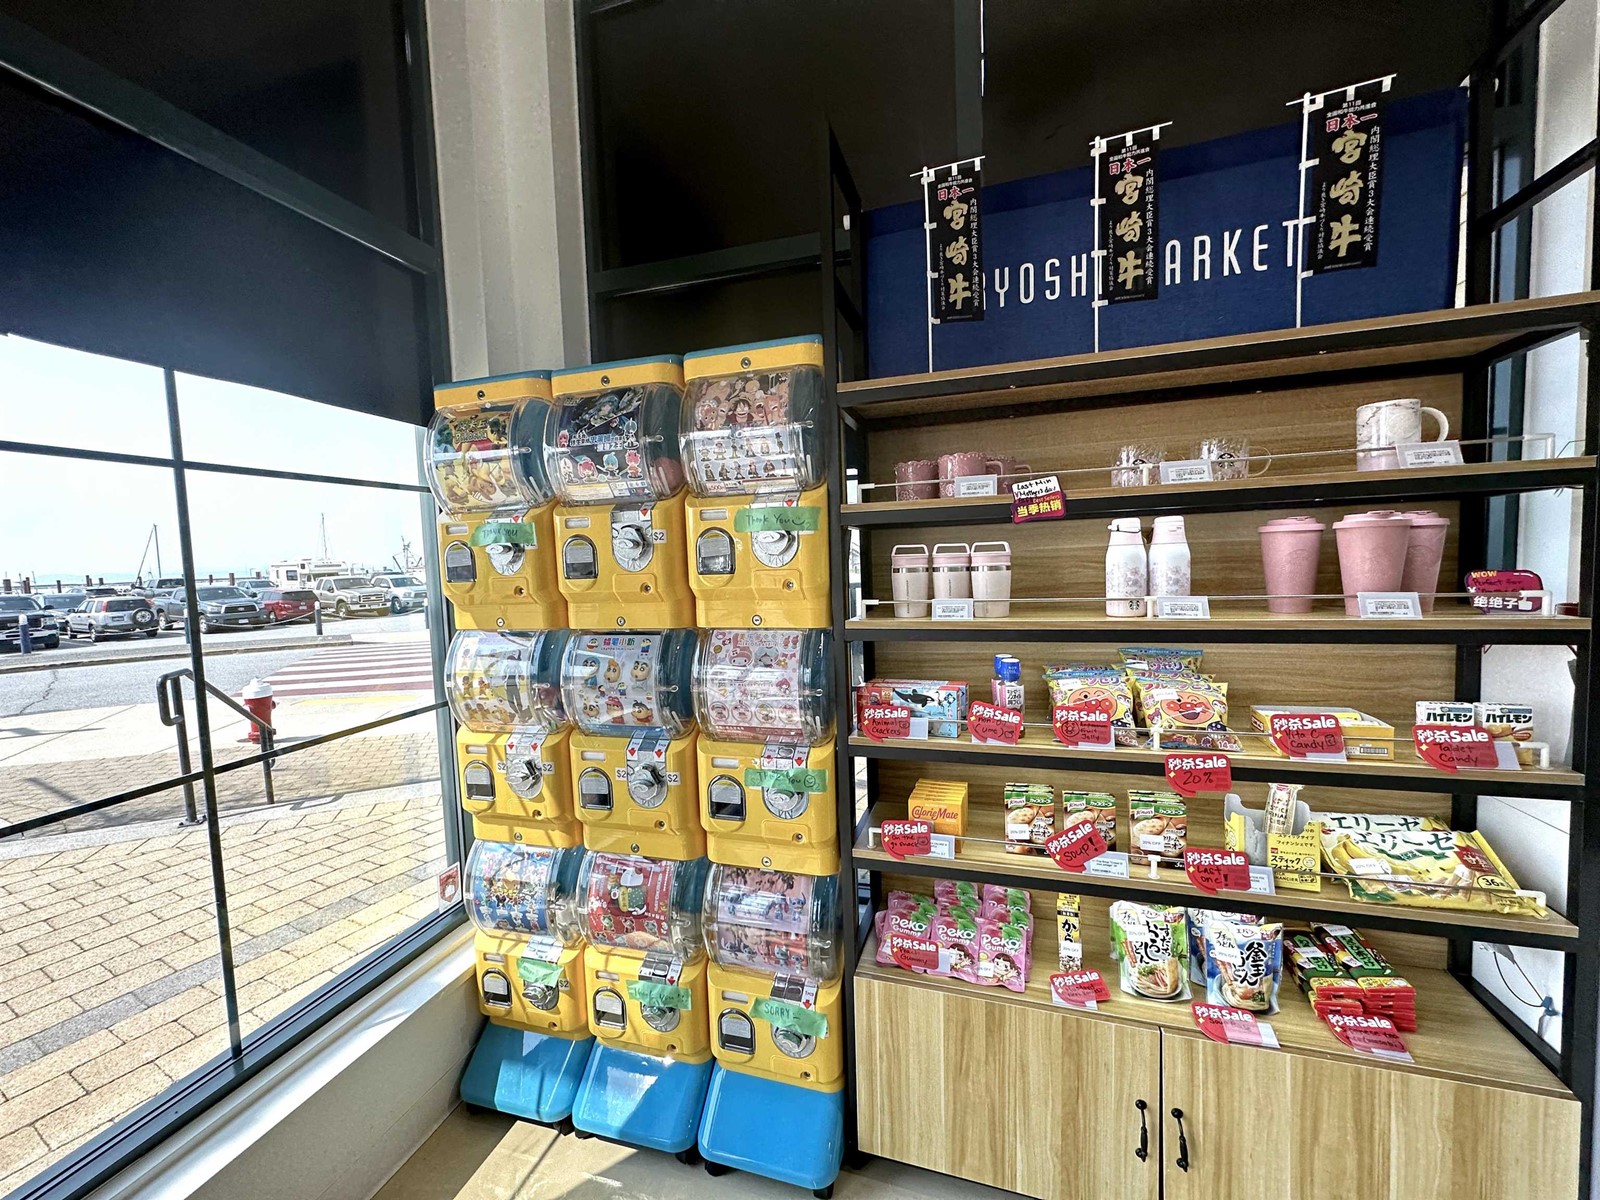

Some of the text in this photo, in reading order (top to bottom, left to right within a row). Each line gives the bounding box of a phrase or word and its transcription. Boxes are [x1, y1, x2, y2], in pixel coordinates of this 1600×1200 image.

[1325, 112, 1378, 133] 日本一
[1108, 156, 1152, 176] 日本一
[937, 185, 975, 201] 日本一
[1328, 129, 1369, 257] 宮崎牛
[1114, 173, 1145, 290] 宮崎牛
[943, 199, 972, 310] 宮崎牛
[982, 220, 1299, 311] YOSHI ARKET
[1017, 478, 1052, 491] Last Min
[1017, 499, 1062, 518] 当季热销
[745, 513, 791, 526] Thank You
[481, 527, 518, 539] THANK YOU
[653, 531, 665, 542] $2
[1471, 570, 1497, 578] WOW
[1473, 595, 1519, 609] 绝绝子
[864, 707, 909, 719] 秒杀Sale
[971, 704, 1021, 722] 秒杀Sale
[1055, 709, 1108, 722] 秒杀Sale
[1426, 712, 1473, 723] ハイレモン
[1485, 713, 1533, 724] ハイレモン
[1273, 716, 1336, 731] 秒杀Sale
[1285, 730, 1320, 740] Vita C
[1416, 728, 1489, 743] 秒杀Sale
[497, 762, 506, 771] $2
[542, 763, 553, 772] $2
[1167, 755, 1228, 770] 秒杀Sale
[616, 769, 627, 779] $2
[667, 773, 679, 783] $2
[883, 822, 929, 836] 秒杀Sale
[1330, 816, 1421, 831] エリーゼ
[1047, 822, 1093, 854] 秒杀Sale
[1354, 832, 1456, 852] エリーゼ
[1164, 842, 1185, 850] ニオン
[1186, 851, 1246, 866] 秒杀Sale
[1270, 855, 1301, 864] スティック
[890, 914, 928, 931] Peko
[937, 924, 976, 940] Peko
[940, 934, 970, 945] Gummy
[1159, 923, 1171, 956] すだち
[892, 936, 937, 952] 秒杀Sale
[981, 934, 1022, 949] Peko
[985, 943, 1016, 955] Gummy
[1216, 940, 1236, 949] うどん
[1245, 941, 1268, 978] 釜玉
[559, 979, 569, 988] $2
[1053, 971, 1100, 987] 秒杀Sale
[763, 1002, 791, 1019] SORRY
[1194, 1005, 1253, 1022] 秒杀Sale
[1328, 1014, 1393, 1029] 秒杀Sale
